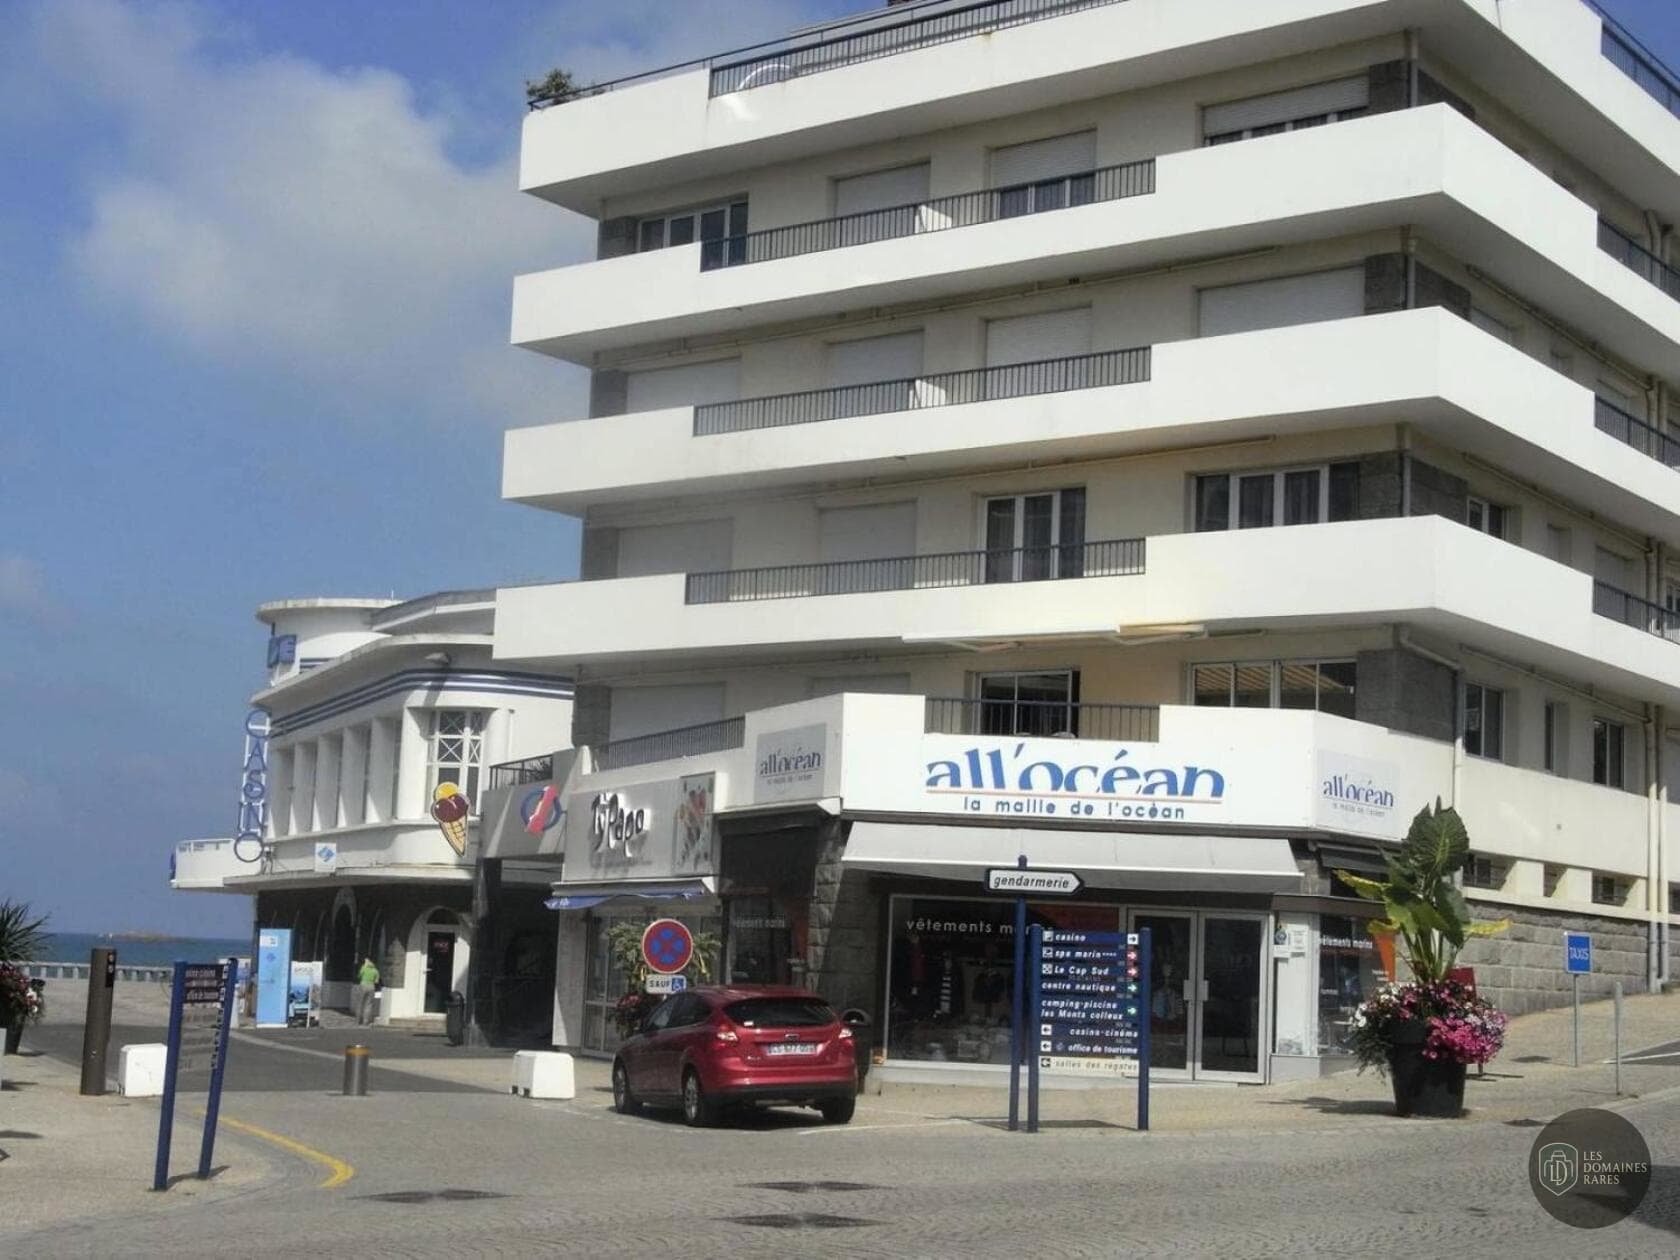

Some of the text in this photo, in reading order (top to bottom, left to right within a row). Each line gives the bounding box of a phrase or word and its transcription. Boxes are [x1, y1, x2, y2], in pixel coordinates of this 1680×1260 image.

[925, 743, 1225, 798] all'océan
[234, 709, 271, 863] CASINO
[1323, 773, 1394, 808] all'océan
[964, 796, 1185, 819] la maille de l'océan
[993, 874, 1070, 890] gendarmerie
[906, 918, 992, 933] vêtements
[1055, 934, 1087, 942] casino
[1055, 950, 1071, 959] spa
[1569, 947, 1589, 960] TAXIS
[1068, 966, 1087, 975] Cap
[1091, 967, 1110, 975] Sud
[649, 980, 670, 988] SAUF
[1041, 982, 1116, 993] centre nautique
[1041, 1009, 1055, 1018] les
[1058, 1010, 1086, 1019] Monts
[1068, 1043, 1138, 1055] office de tourisme
